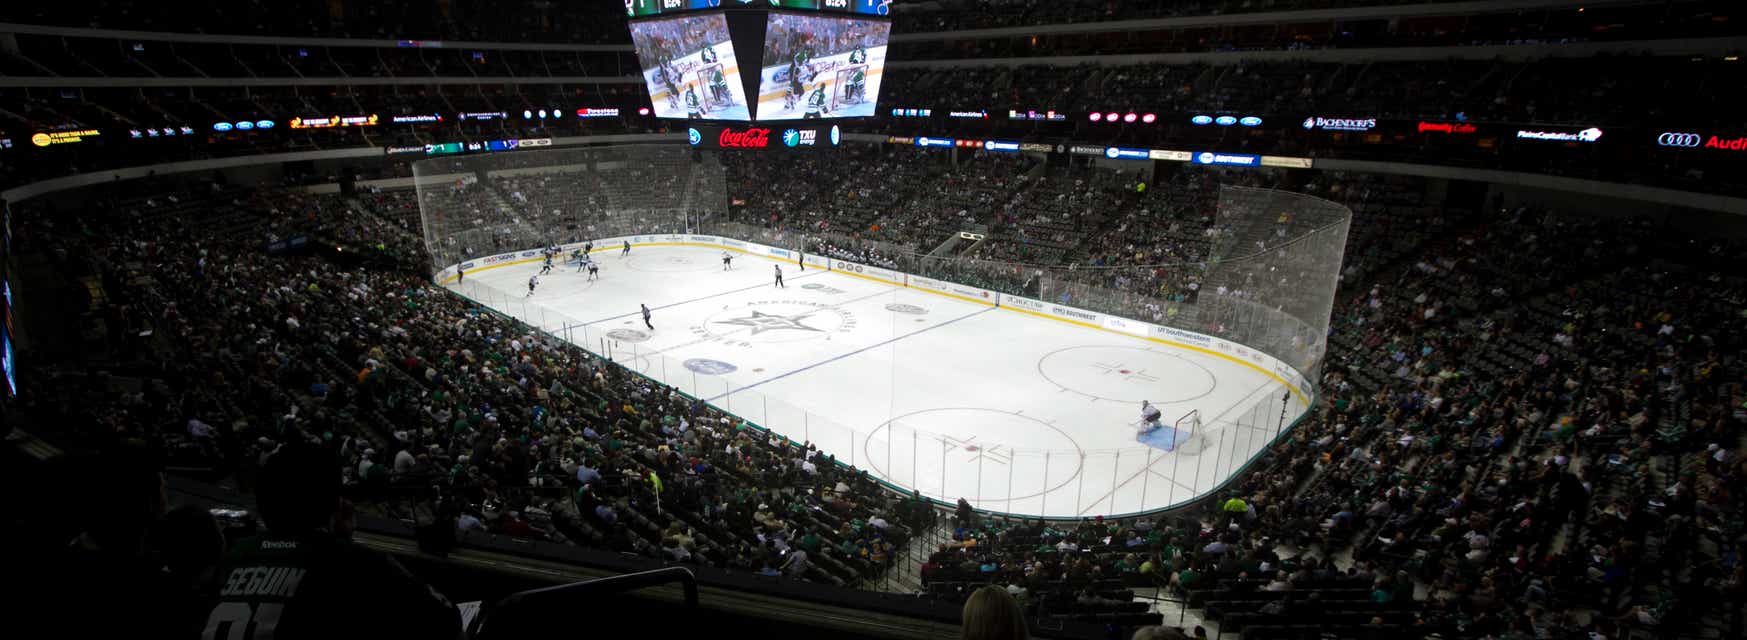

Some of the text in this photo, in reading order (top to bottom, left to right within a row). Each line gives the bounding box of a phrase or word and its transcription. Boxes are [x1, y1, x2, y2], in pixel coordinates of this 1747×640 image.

[719, 128, 771, 148] Coca-Cola
[799, 129, 816, 140] TXU
[1704, 135, 1747, 151] Audi
[221, 567, 306, 597] SEGUIN
